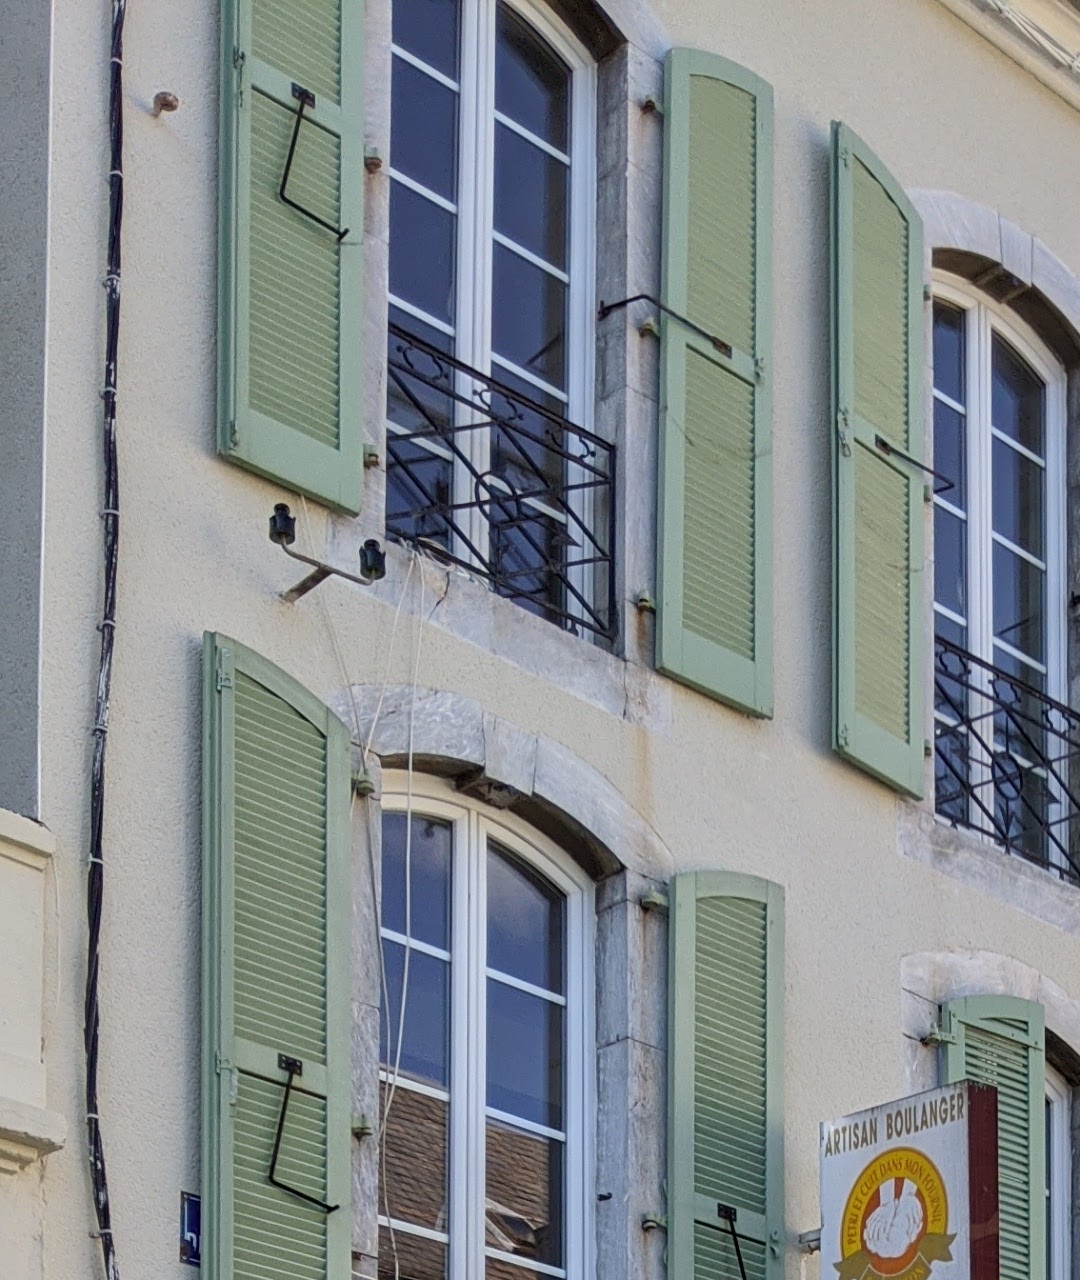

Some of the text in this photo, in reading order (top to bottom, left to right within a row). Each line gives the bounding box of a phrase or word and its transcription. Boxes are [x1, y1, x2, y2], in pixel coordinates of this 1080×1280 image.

[825, 1092, 965, 1158] ARTISAN BOULANGER
[879, 1157, 903, 1177] DANS
[904, 1158, 923, 1179] MON
